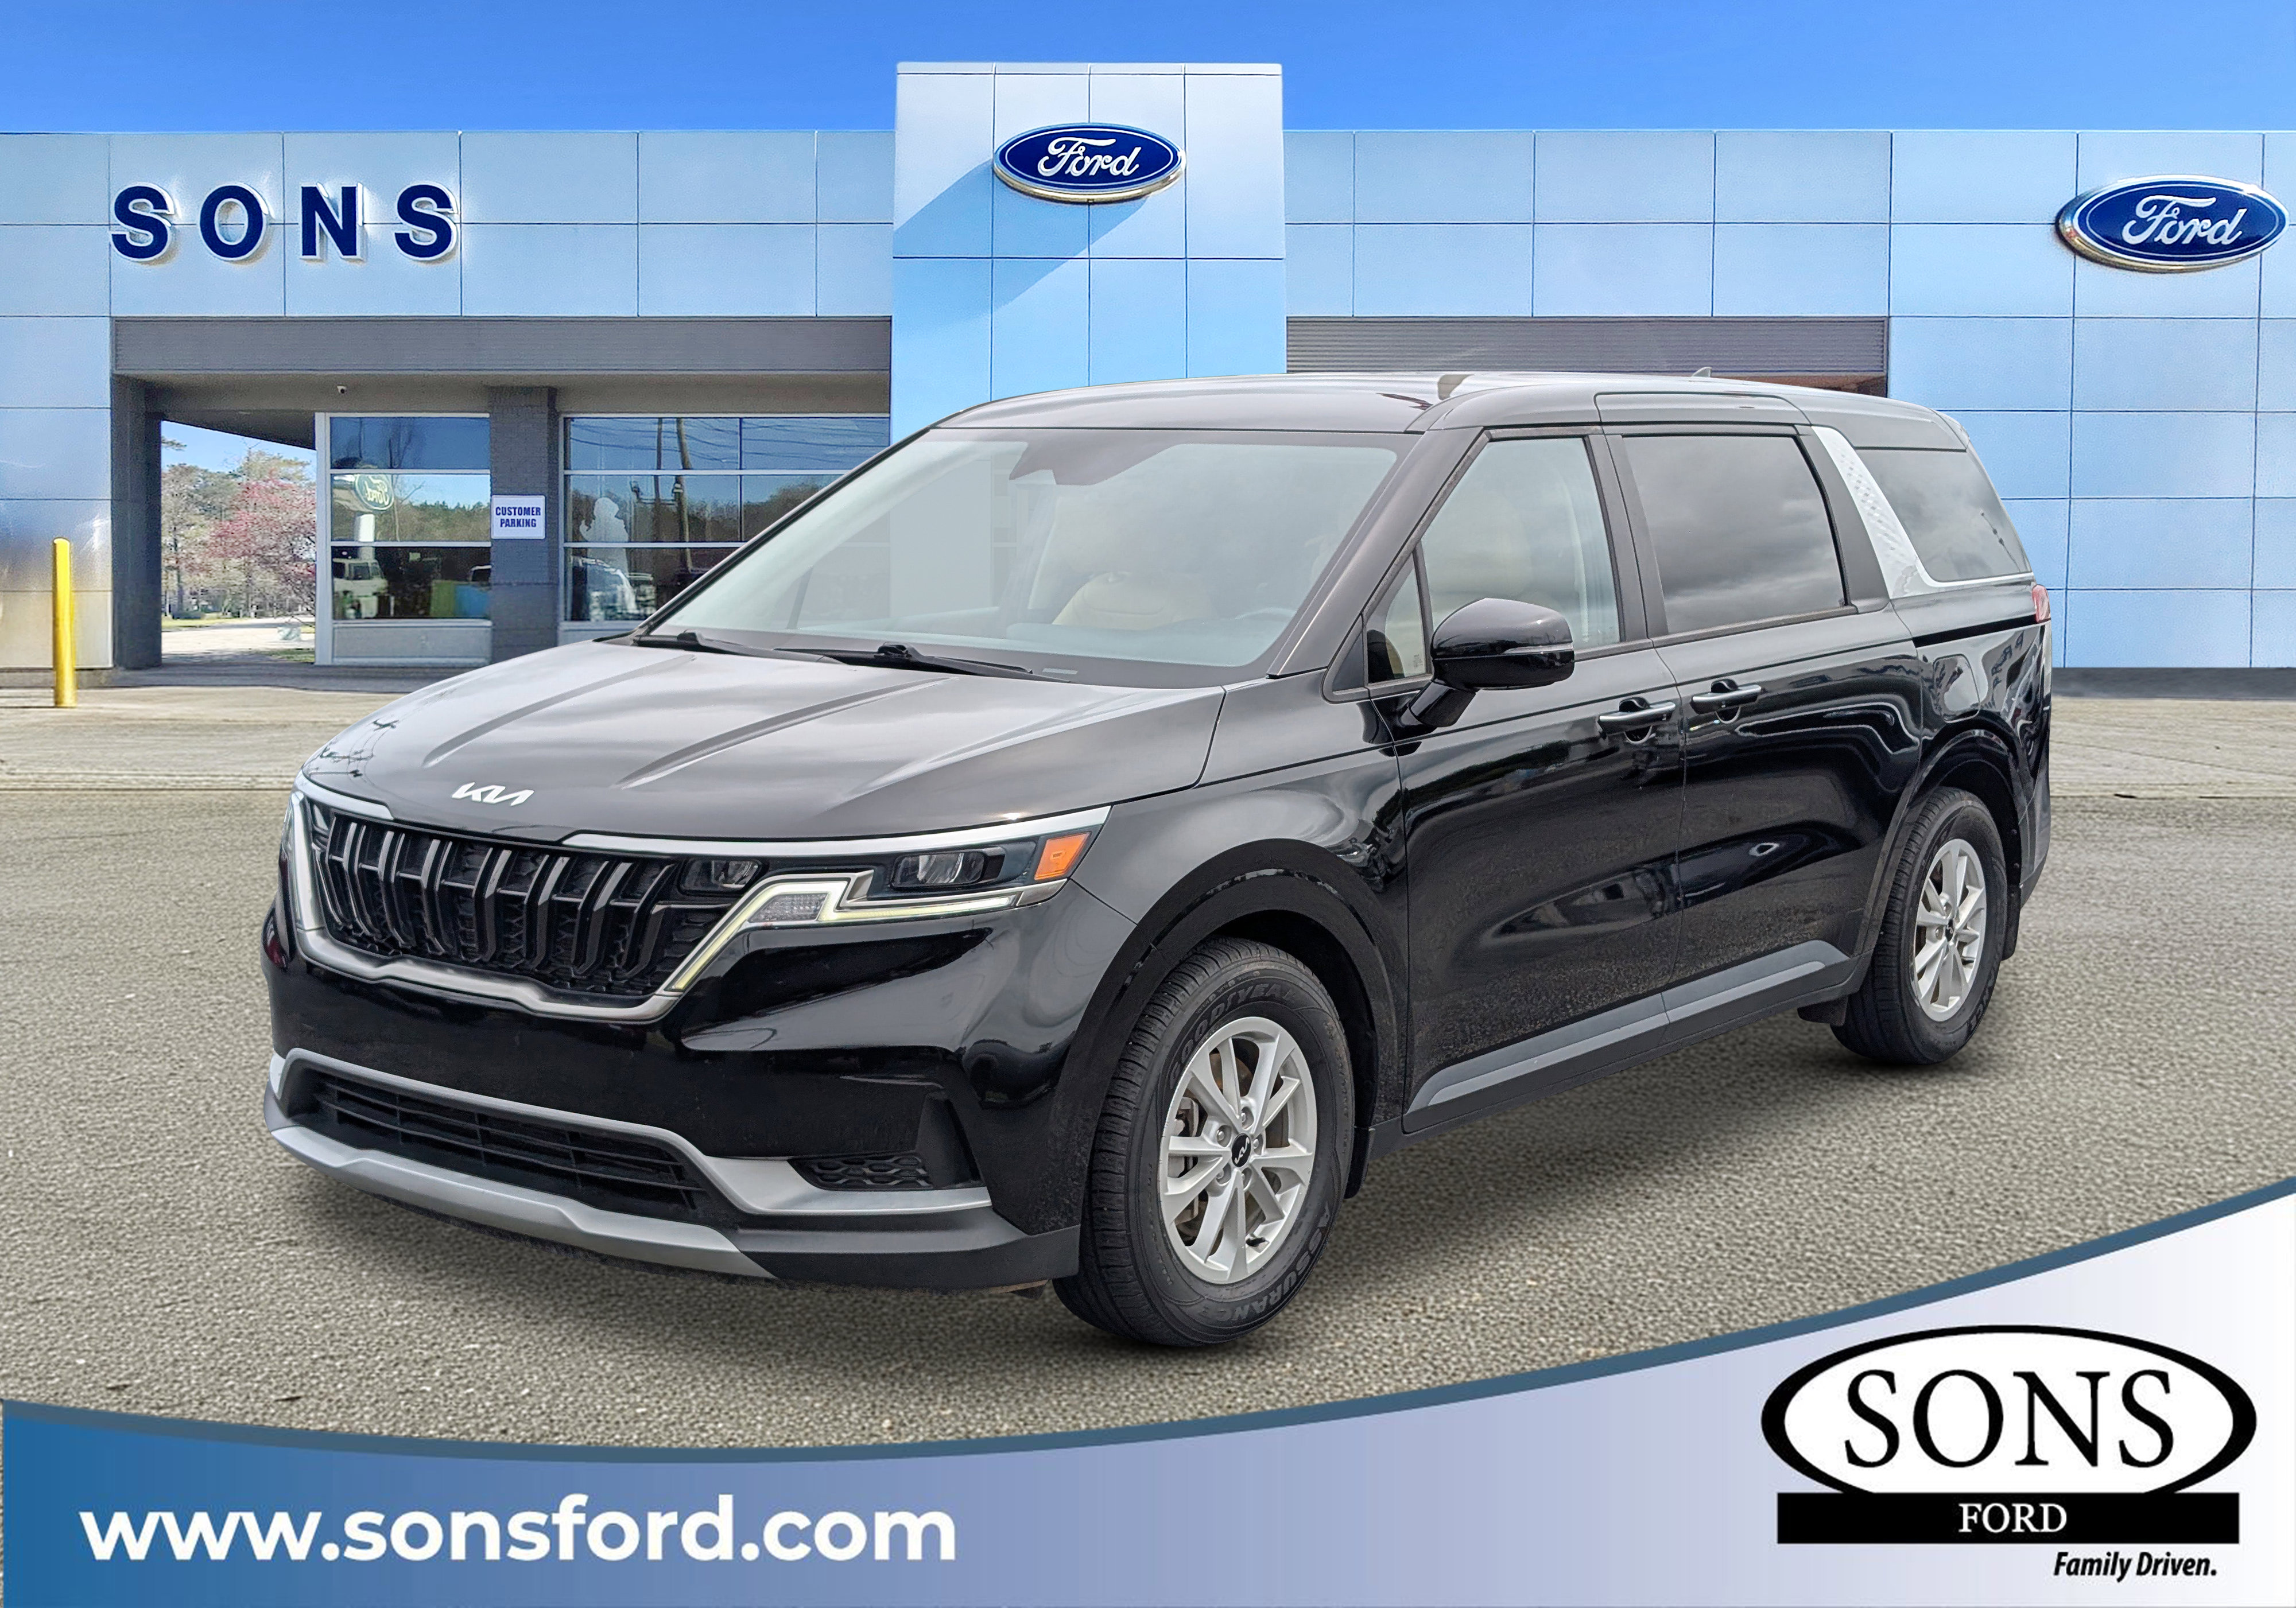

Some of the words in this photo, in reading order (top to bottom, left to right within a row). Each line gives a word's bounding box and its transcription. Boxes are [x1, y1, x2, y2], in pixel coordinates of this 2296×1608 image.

[1037, 136, 1142, 177] Ford
[111, 184, 457, 259] SONS
[2122, 195, 2248, 245] Ford
[495, 506, 541, 516] CUSTOMER
[500, 518, 537, 527] PARKING
[452, 782, 534, 806] KIA
